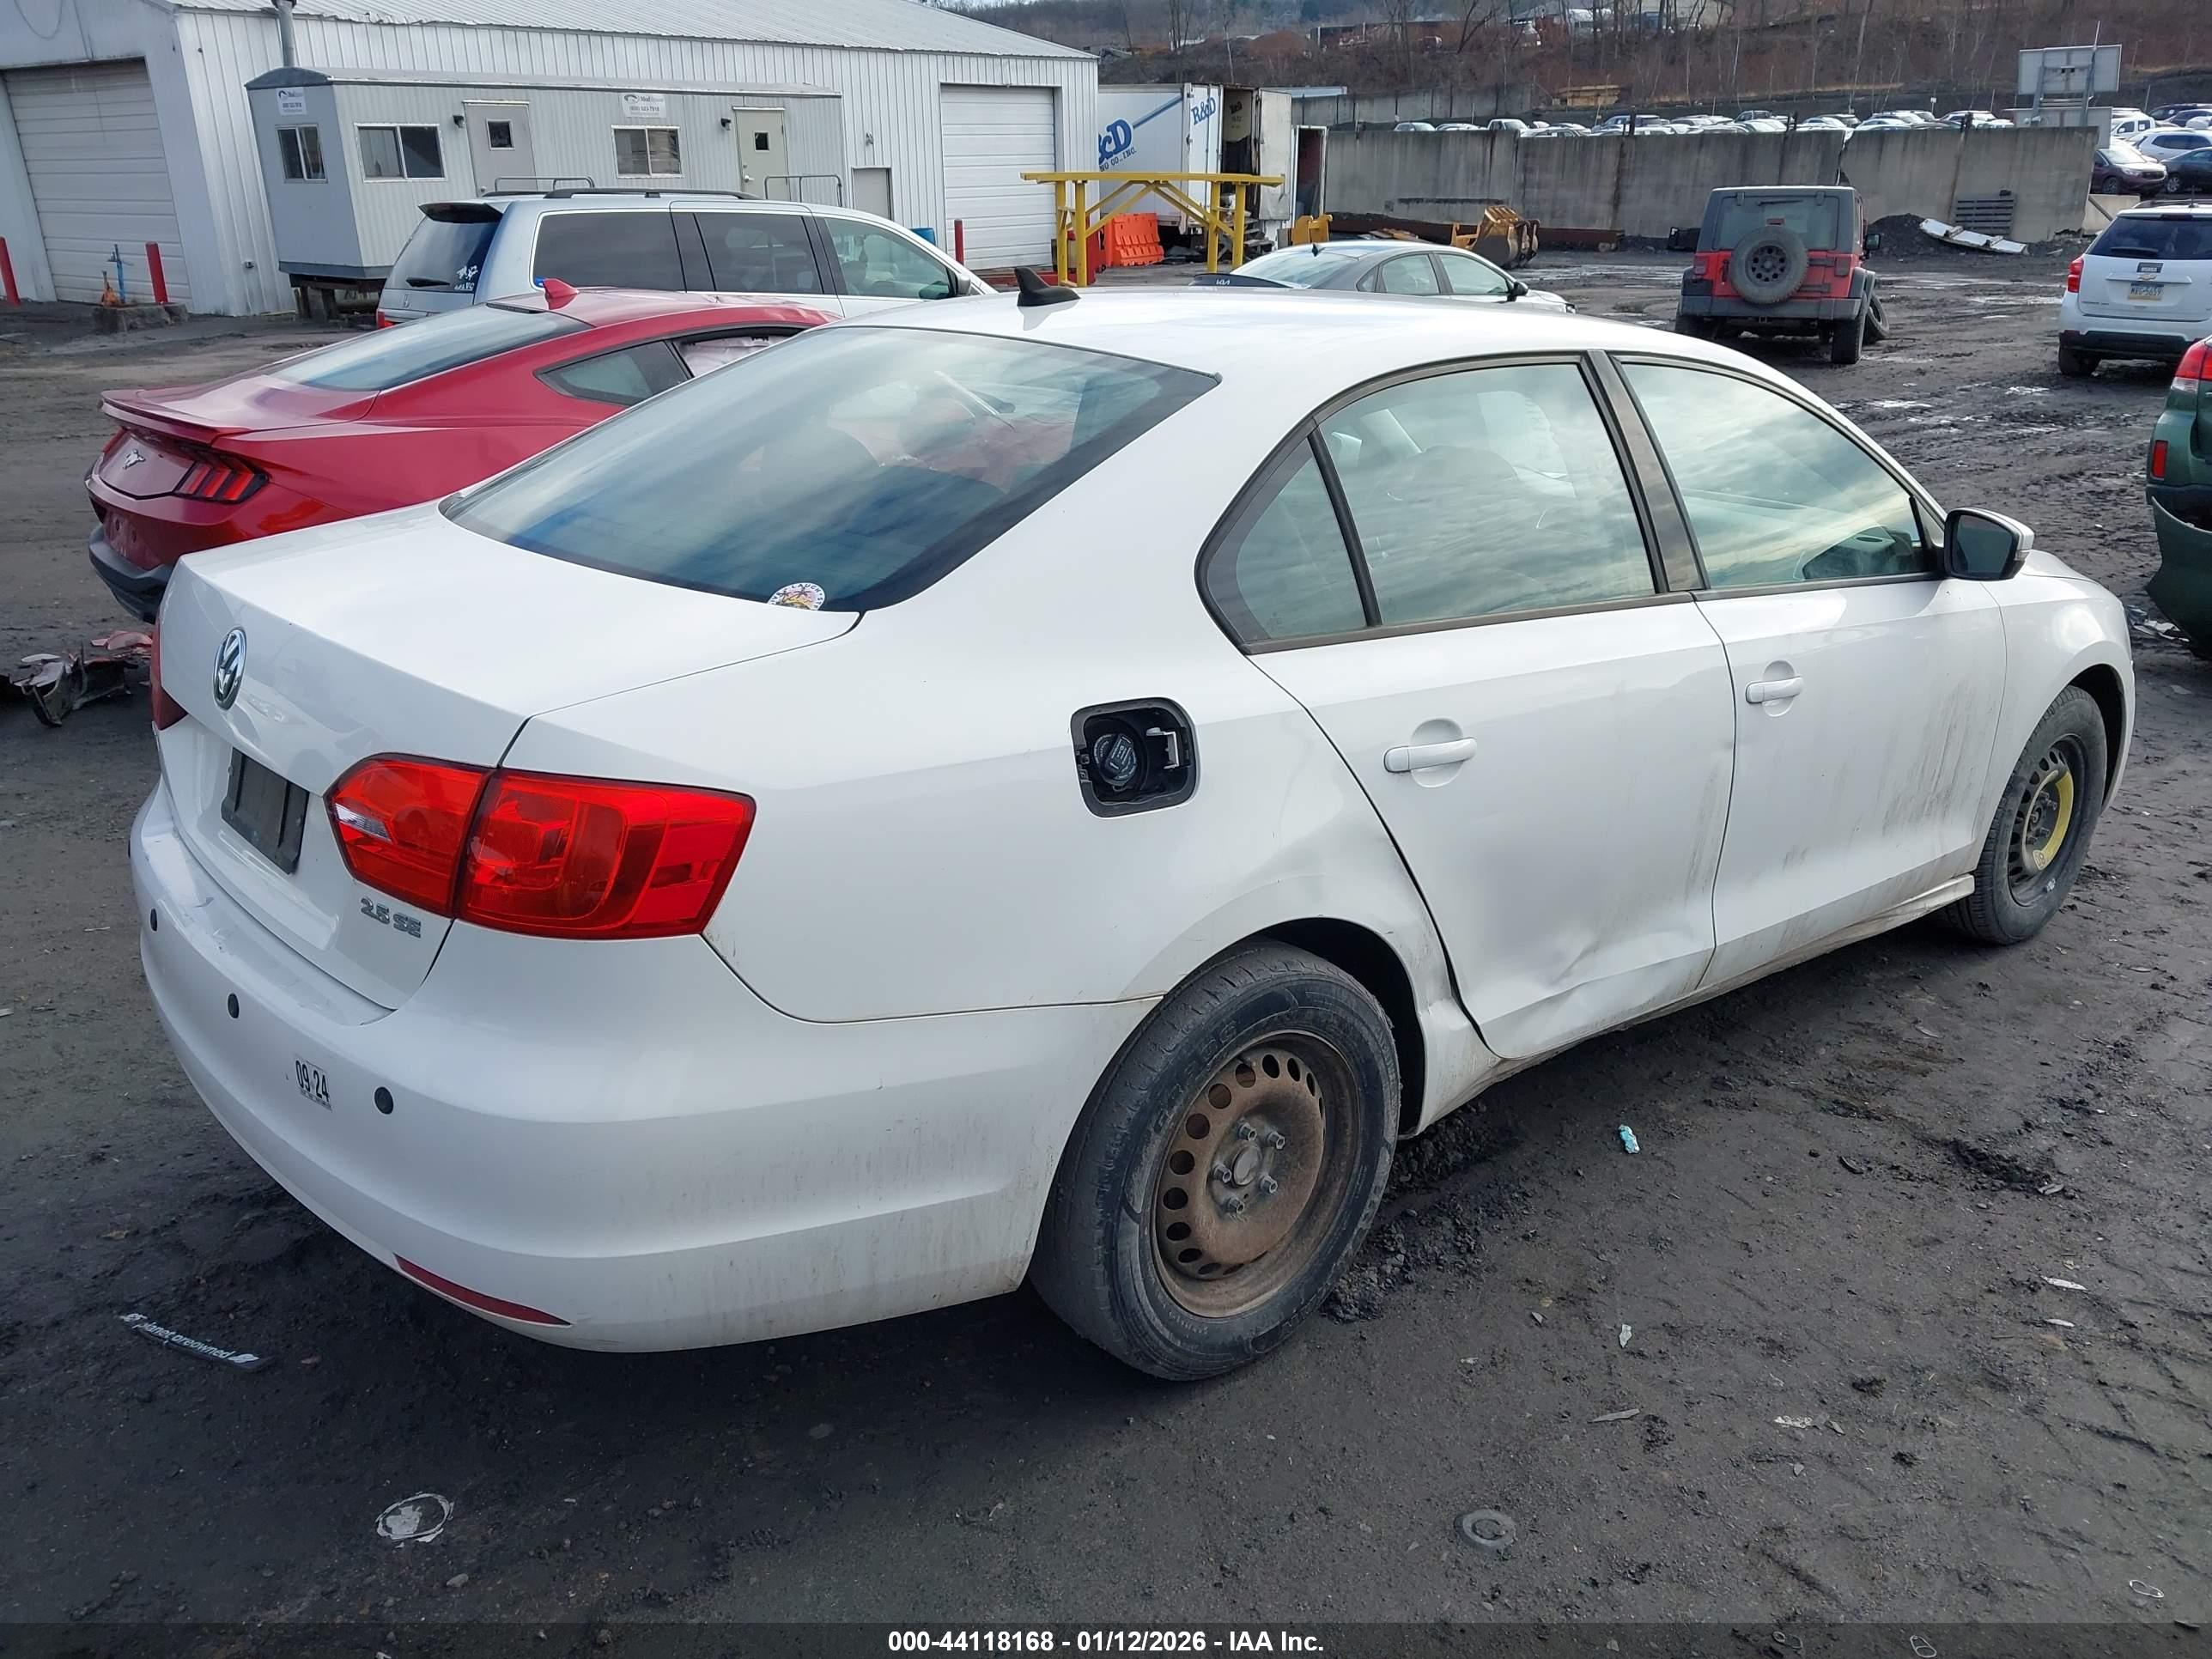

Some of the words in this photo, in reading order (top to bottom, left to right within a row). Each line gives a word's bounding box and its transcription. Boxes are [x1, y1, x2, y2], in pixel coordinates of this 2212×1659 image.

[1191, 97, 1216, 125] R&D
[791, 583, 822, 593] LAUGH
[393, 914, 421, 939] SE
[295, 1060, 311, 1093] 09
[313, 1070, 330, 1103] 24
